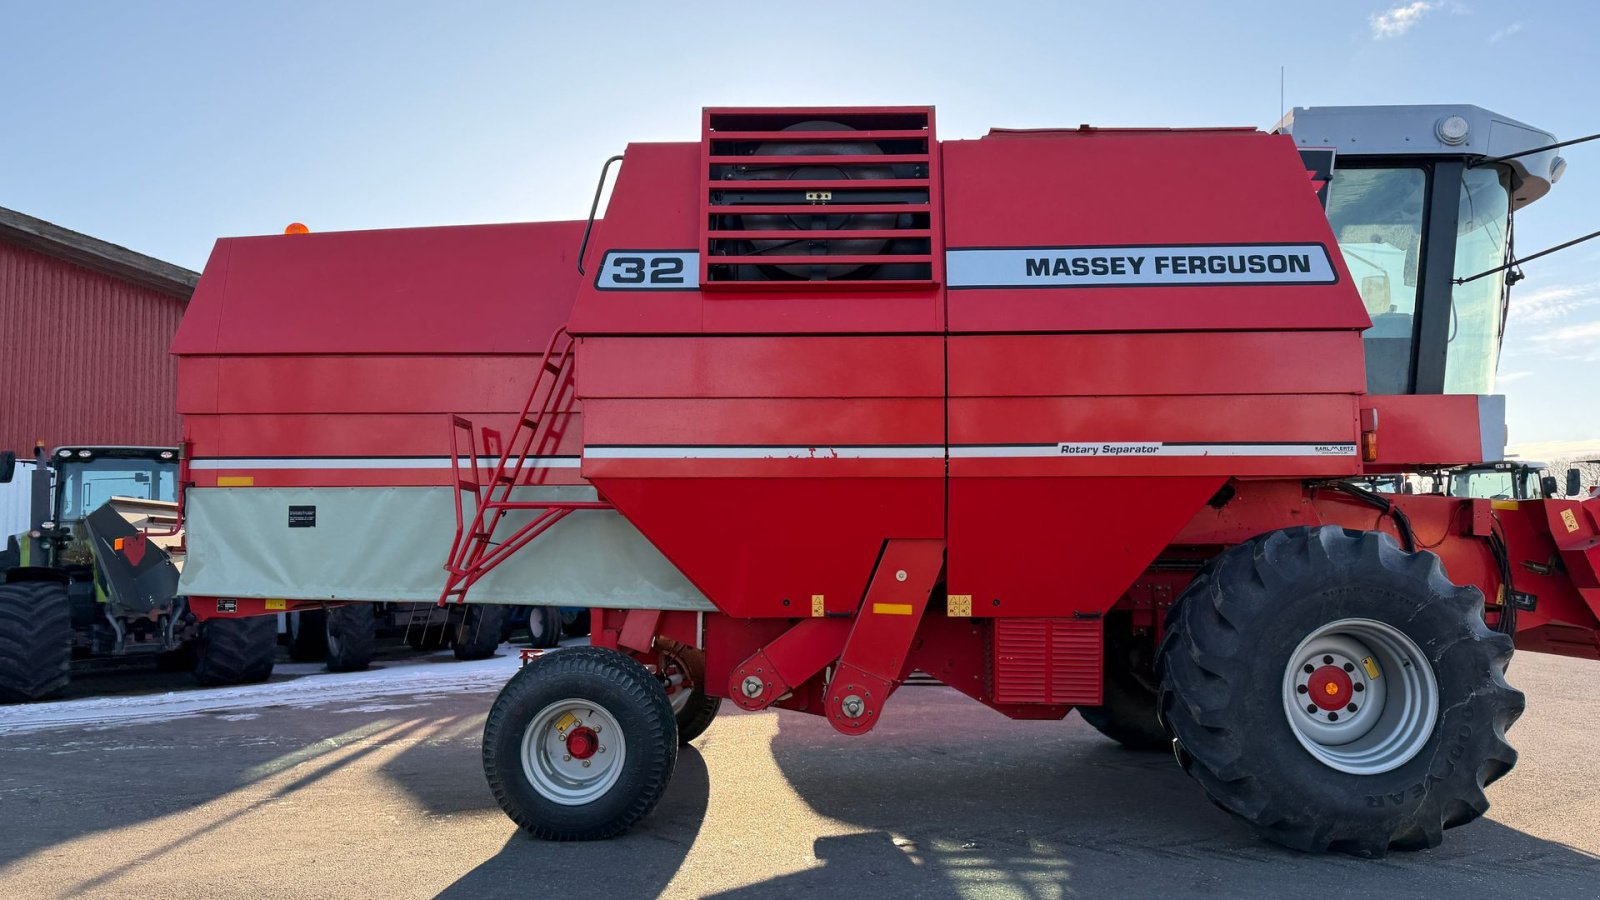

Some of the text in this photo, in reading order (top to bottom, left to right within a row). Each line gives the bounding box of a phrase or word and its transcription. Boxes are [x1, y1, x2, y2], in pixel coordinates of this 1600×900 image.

[612, 257, 684, 283] 32
[1026, 254, 1311, 276] MASSEY FERGUSON
[1061, 445, 1159, 455] Rotary Separator
